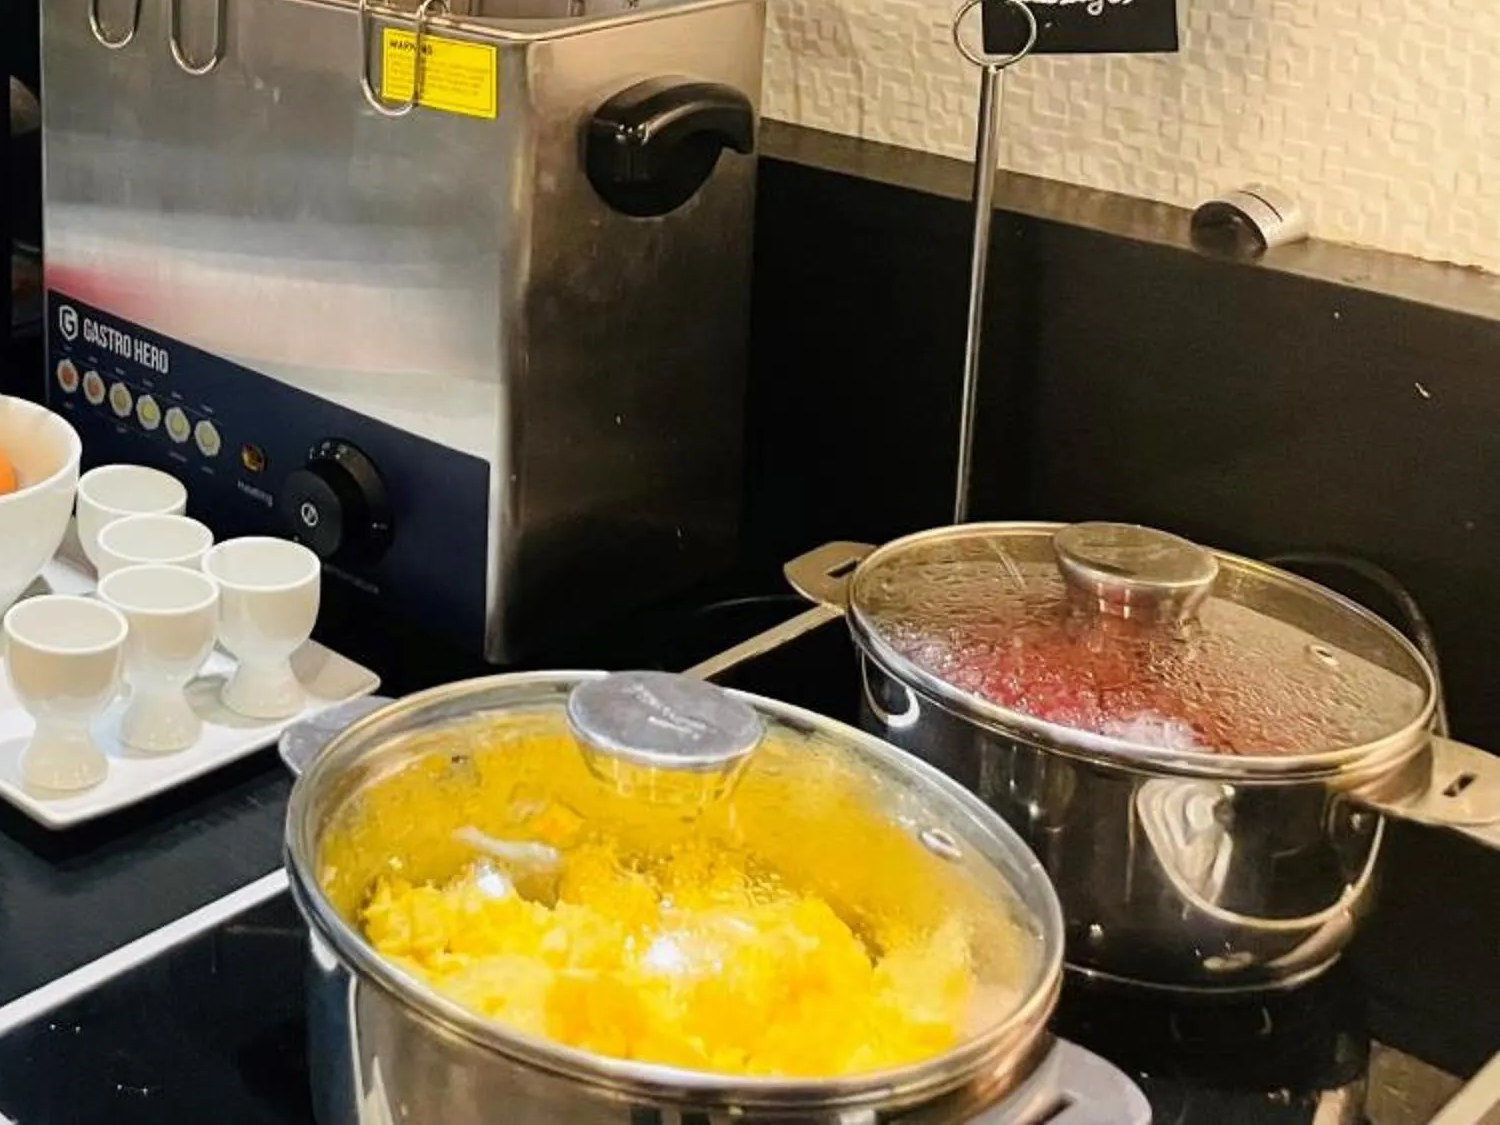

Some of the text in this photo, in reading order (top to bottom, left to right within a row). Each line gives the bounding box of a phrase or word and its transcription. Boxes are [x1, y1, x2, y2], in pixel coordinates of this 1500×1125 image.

[388, 38, 434, 56] WARNNG
[83, 318, 132, 360] GASTRO
[133, 338, 169, 375] HERO
